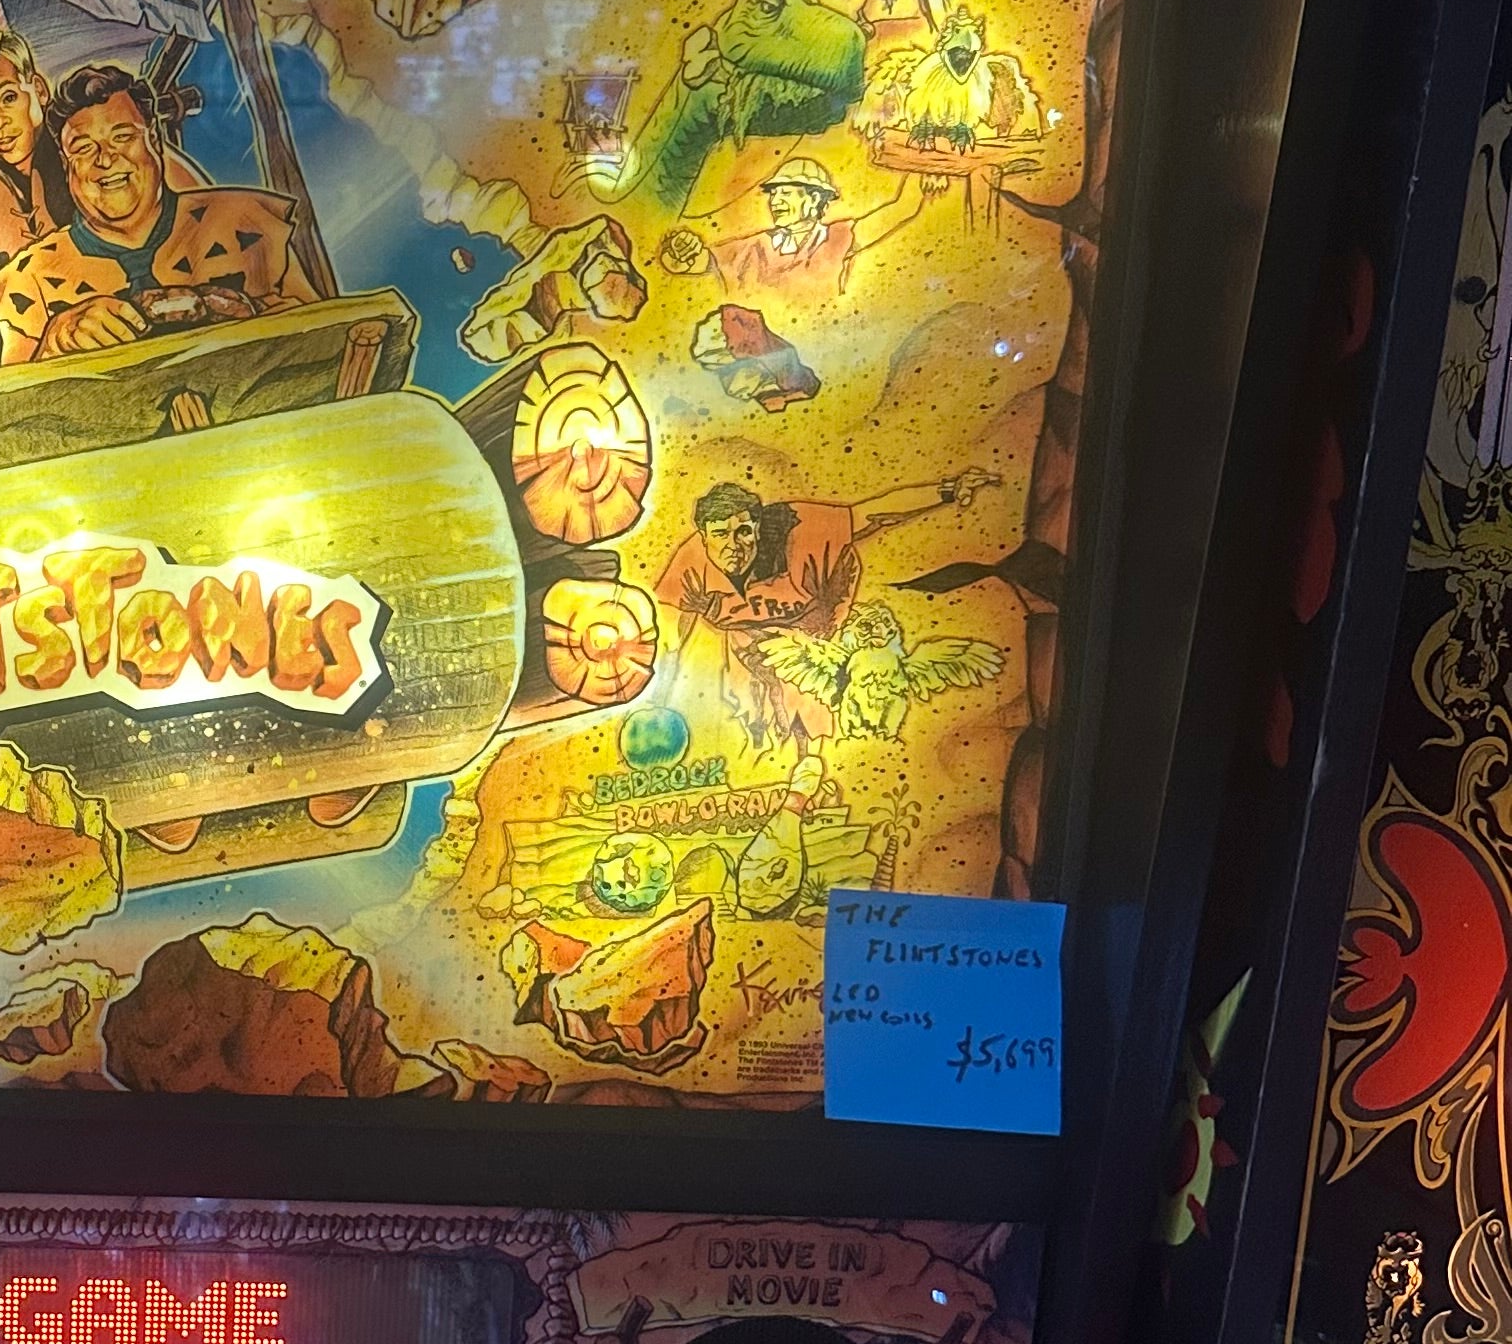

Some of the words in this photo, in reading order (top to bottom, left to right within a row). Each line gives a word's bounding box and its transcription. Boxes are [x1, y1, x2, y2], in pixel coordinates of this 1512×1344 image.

[749, 595, 806, 617] FRED
[594, 757, 727, 805] BEDROCK
[836, 903, 912, 927] THE
[866, 938, 1043, 968] FLINTSTONES
[947, 1025, 1055, 1084] $5,699
[708, 1237, 816, 1270] DRIVE
[828, 1241, 866, 1273] IN
[727, 1274, 844, 1307] MOVIE
